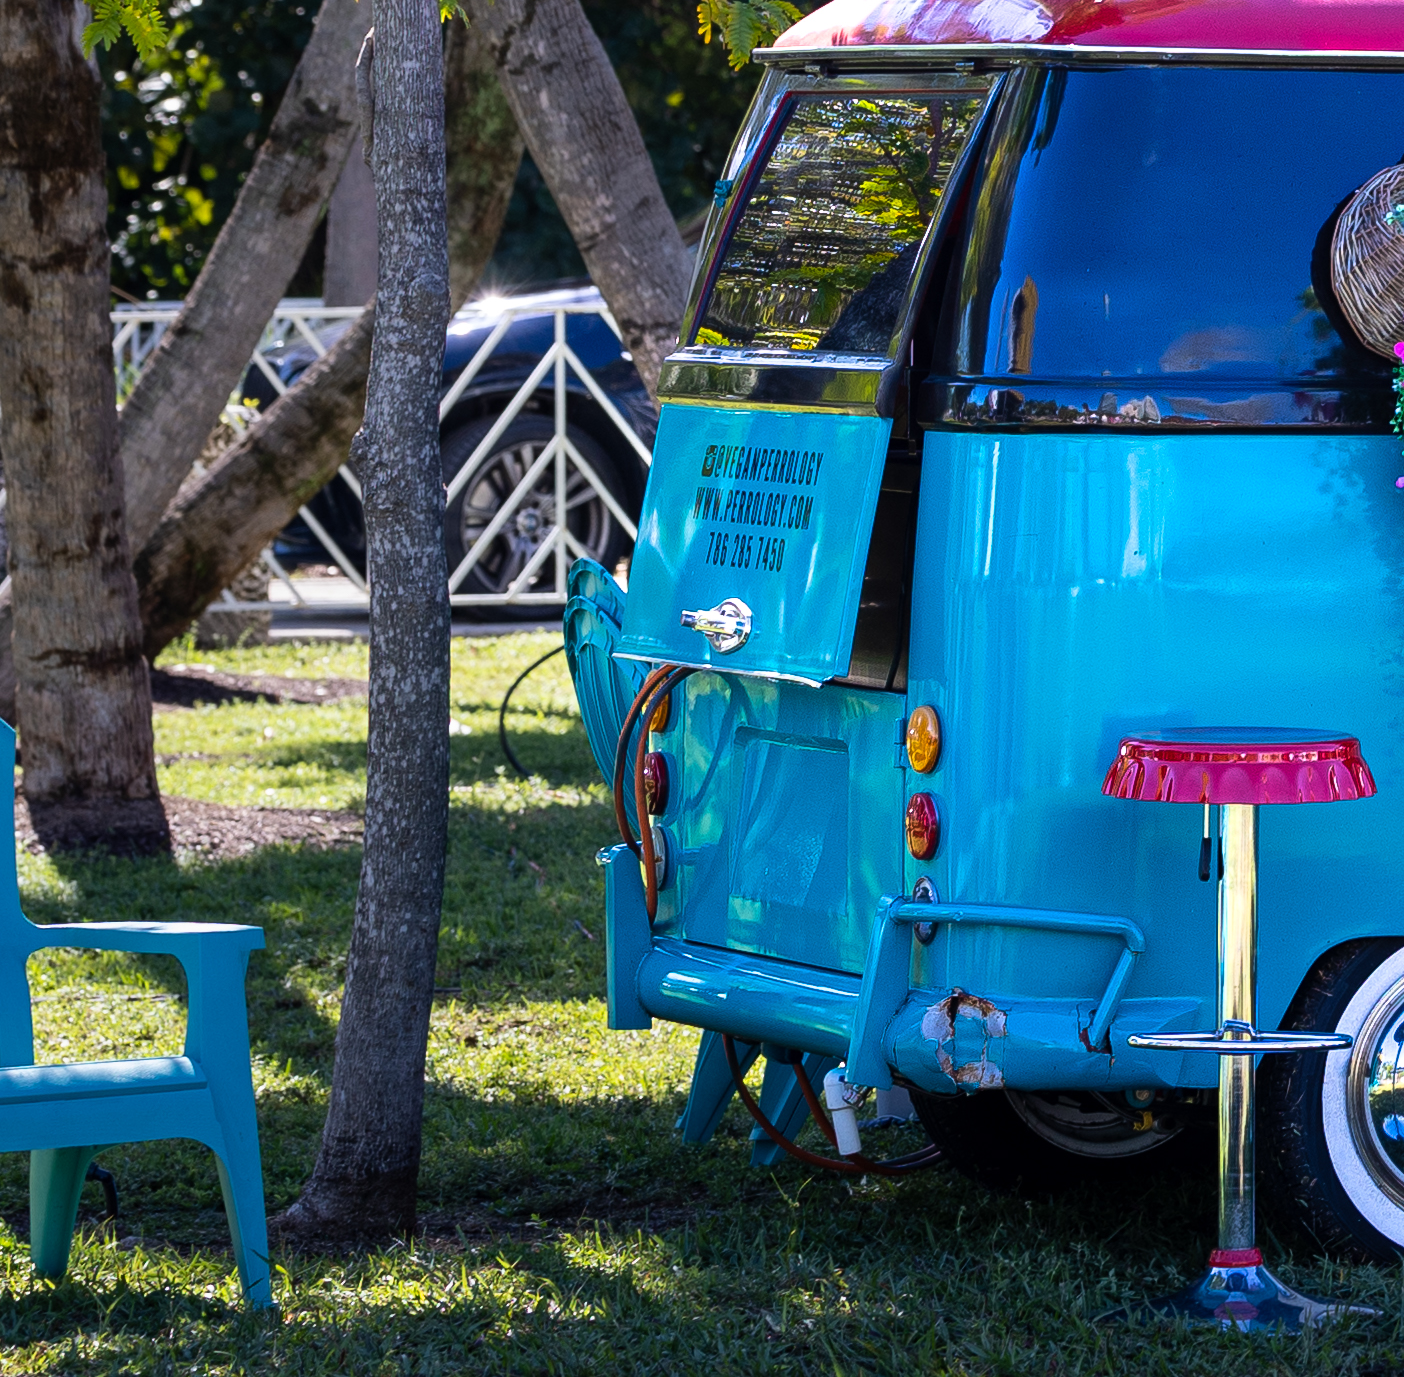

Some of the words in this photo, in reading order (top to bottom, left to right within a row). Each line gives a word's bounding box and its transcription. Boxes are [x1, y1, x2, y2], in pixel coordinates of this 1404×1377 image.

[714, 445, 824, 487] @VEGANPERROLOGY
[693, 487, 814, 530] WWW.PERROLOGY.COM
[706, 532, 729, 566] 786
[730, 534, 753, 569] 285
[755, 537, 785, 573] 7450
